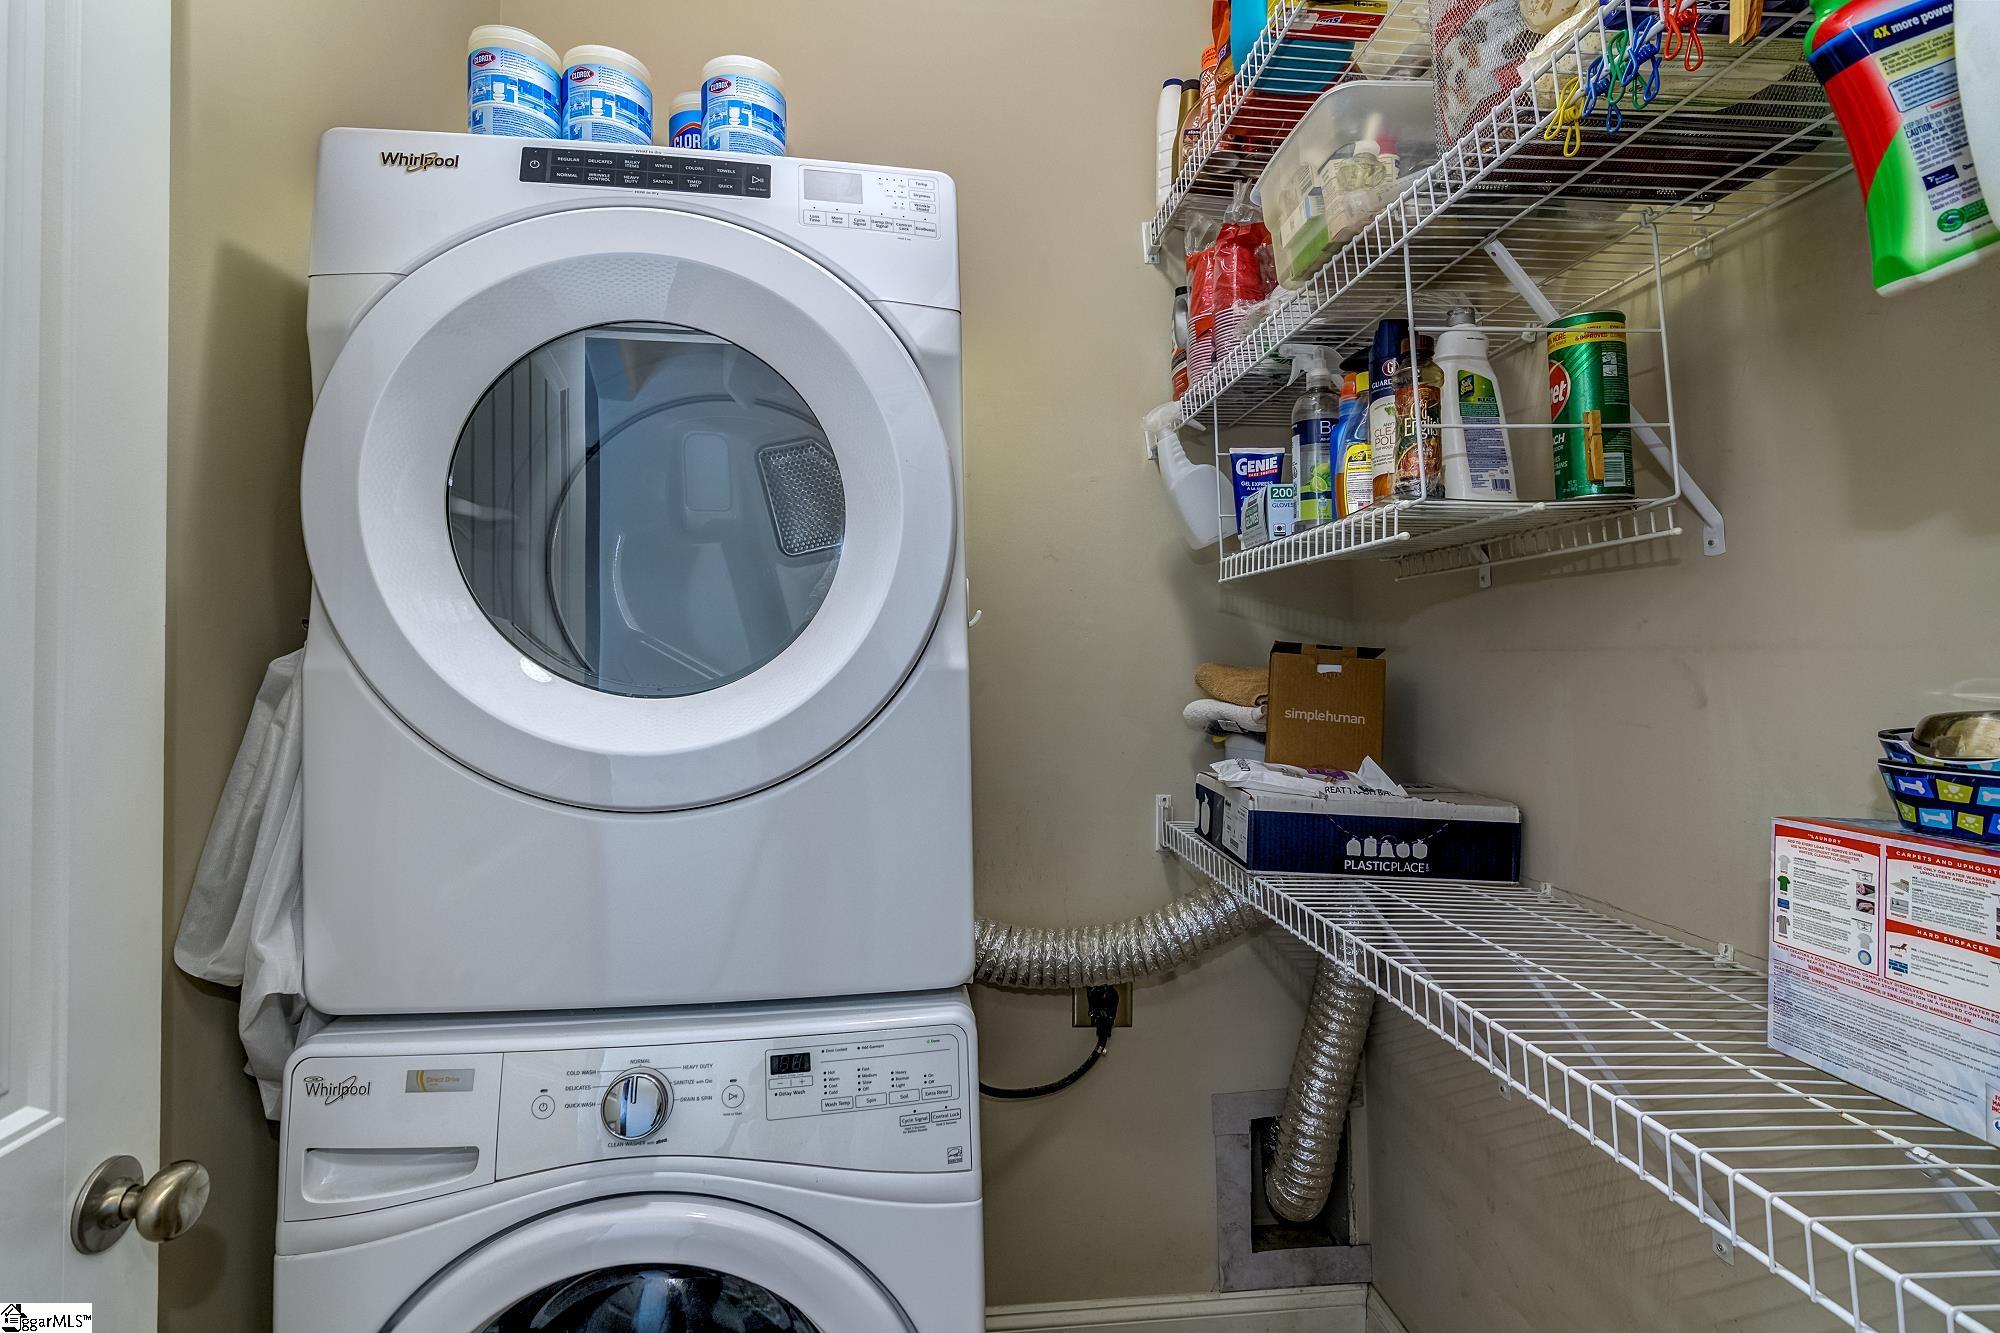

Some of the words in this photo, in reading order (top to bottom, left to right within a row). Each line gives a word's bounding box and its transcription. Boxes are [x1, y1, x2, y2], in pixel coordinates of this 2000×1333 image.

[1874, 25, 1891, 38] 4X
[1890, 16, 1920, 34] more
[1920, 3, 1953, 25] power
[473, 53, 494, 64] CLOROX
[570, 70, 592, 80] CLOROX
[710, 80, 730, 92] CLOROX
[1906, 122, 1934, 138] CAUTION:
[381, 152, 460, 171] Whirlpool
[1236, 456, 1278, 476] GENIE
[1272, 488, 1293, 498] 200
[1284, 708, 1365, 724] simplehuman
[1811, 836, 1842, 844] LAUNDRY
[1808, 848, 1830, 856] DETERGENT
[1896, 850, 1932, 862] CARPETS
[1344, 860, 1424, 872] PLASTICPLACE
[1920, 870, 1952, 881] UPHOLSTERY
[1964, 879, 1989, 888] CARPETS
[1966, 874, 1996, 884] WASHABLE
[1916, 929, 1940, 940] HARD
[1944, 936, 1990, 953] SURFACES
[1786, 968, 1800, 978] BEFORE
[1848, 967, 1861, 976] UNTIL
[1862, 972, 1893, 986] COMPLETELY
[1939, 996, 1966, 1009] WARMEST
[1968, 1006, 1990, 1016] WATER
[1882, 984, 1898, 992] STORE
[1900, 989, 1926, 1001] SOLUTION
[1940, 1002, 1962, 1013] SEALED
[1916, 1002, 1928, 1010] READ
[1929, 1005, 1954, 1018] WARNINGS
[305, 1080, 371, 1100] Whirlpool
